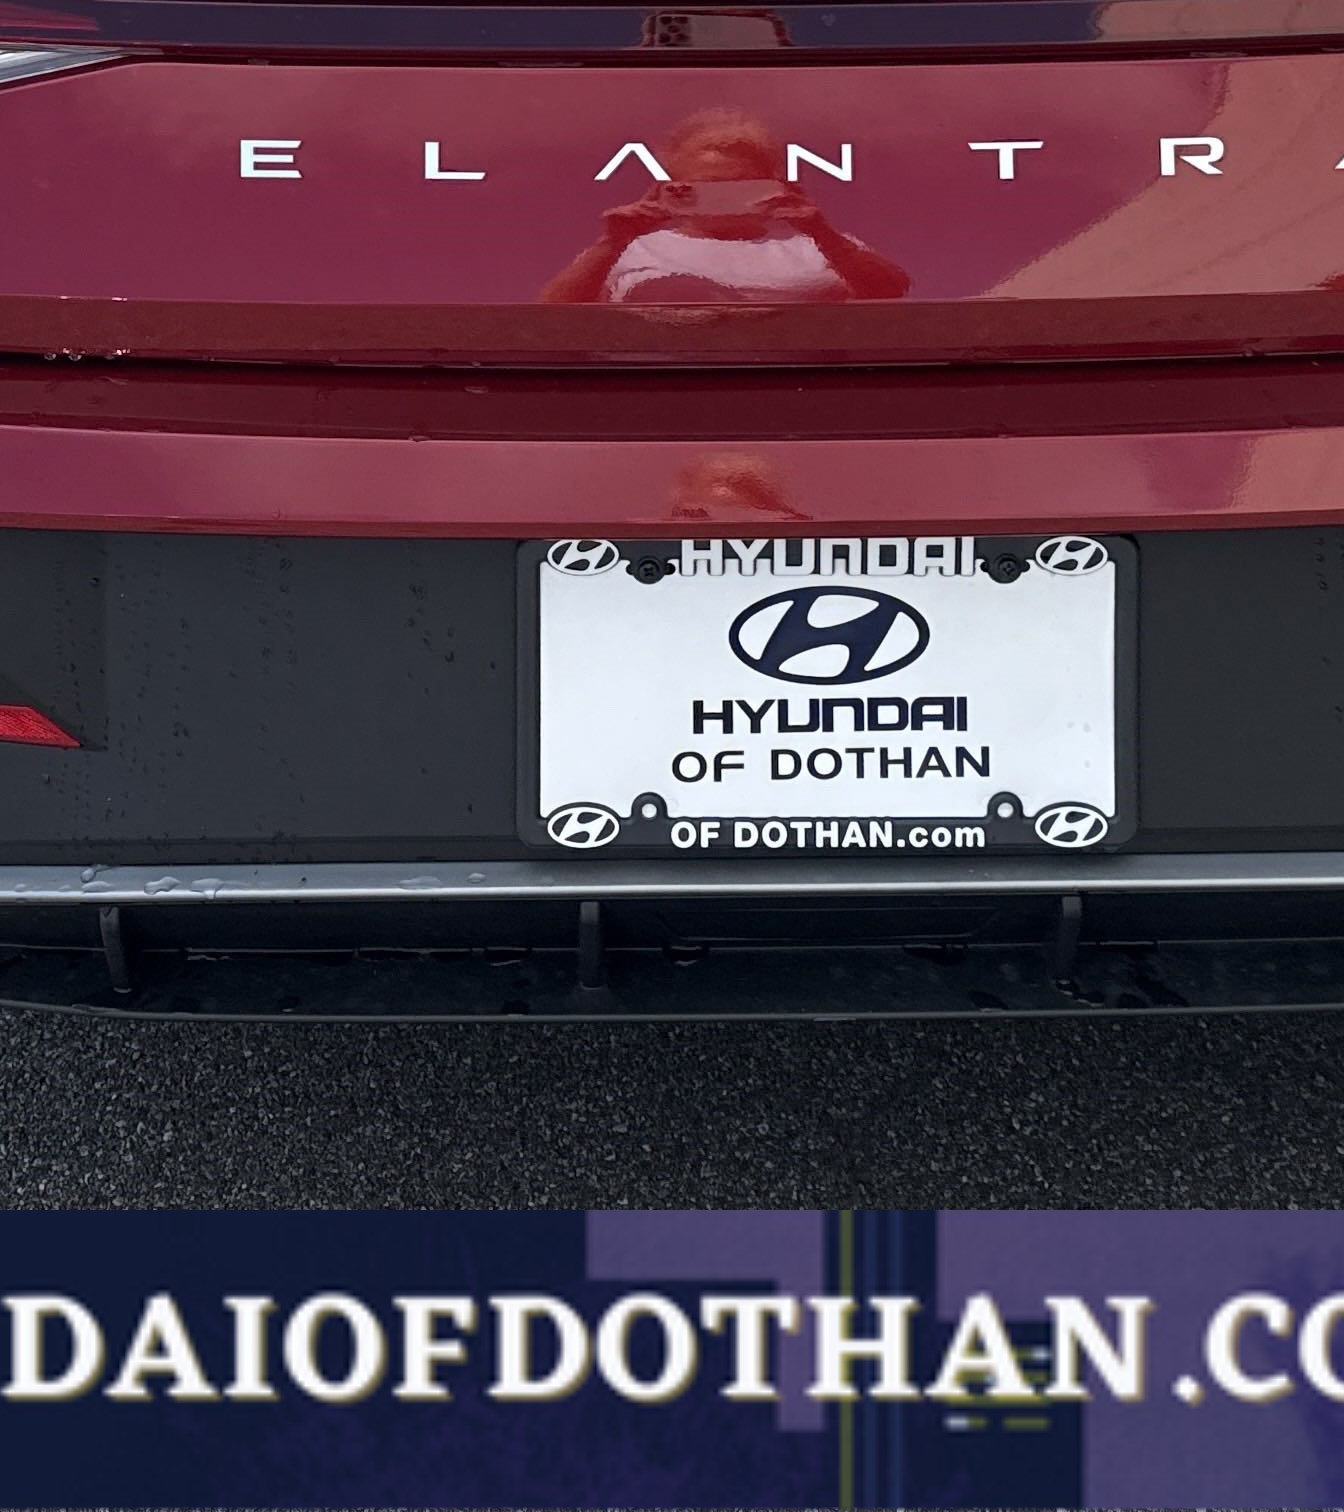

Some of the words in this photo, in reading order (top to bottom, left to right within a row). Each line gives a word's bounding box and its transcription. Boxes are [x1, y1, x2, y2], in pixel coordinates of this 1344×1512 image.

[679, 536, 975, 576] HYUNDAI
[691, 696, 968, 735] HYUNDAI
[670, 749, 746, 784] OF
[769, 745, 991, 782] DOTHAN
[670, 821, 721, 849] OF
[732, 820, 987, 849] DOTHAN.com
